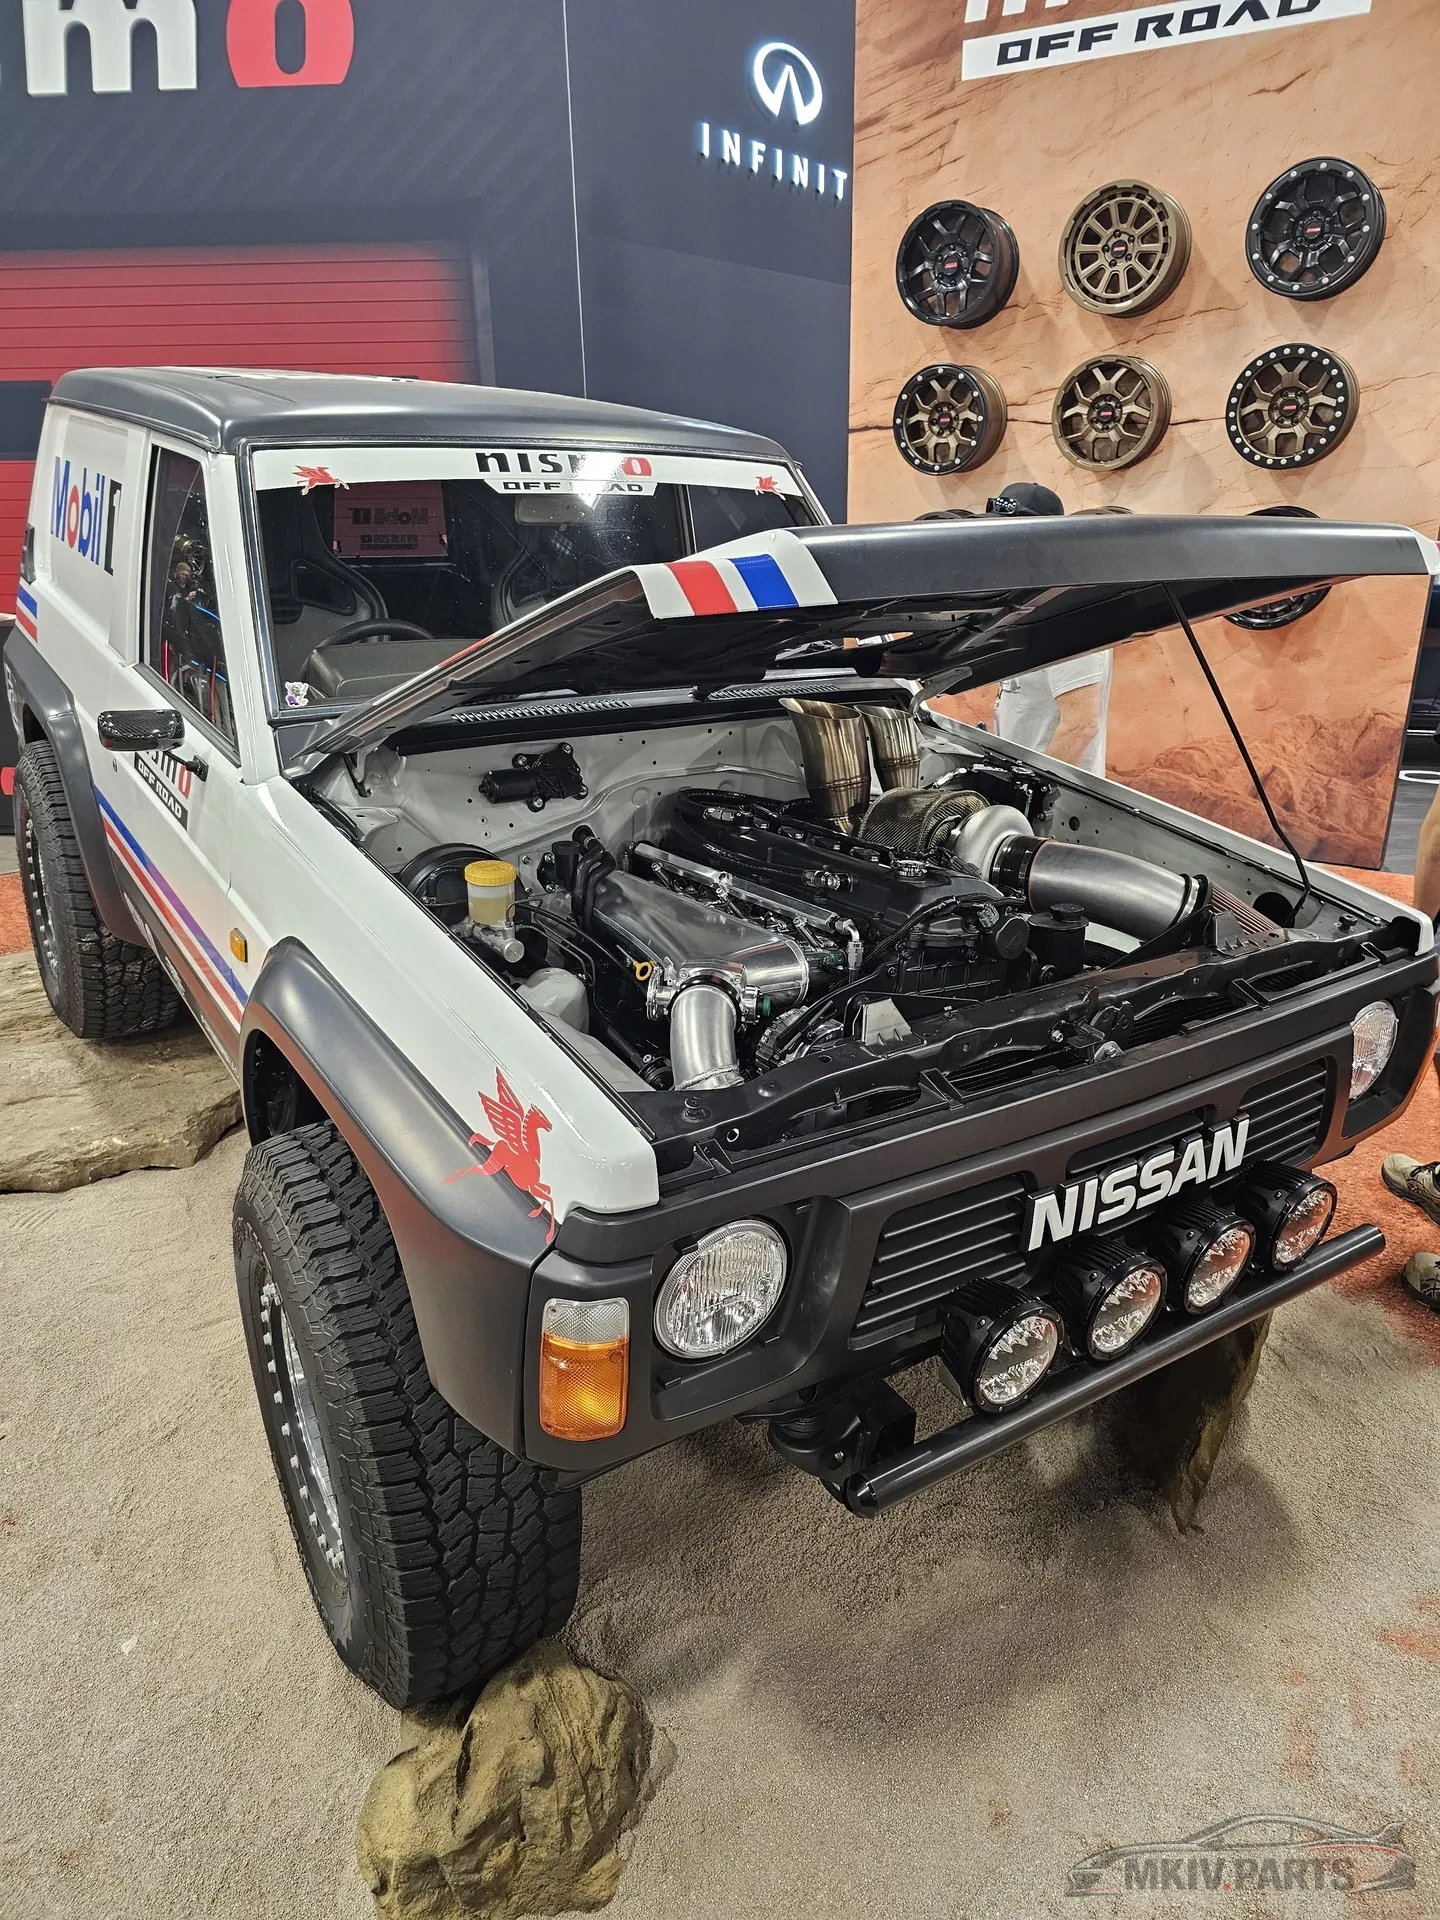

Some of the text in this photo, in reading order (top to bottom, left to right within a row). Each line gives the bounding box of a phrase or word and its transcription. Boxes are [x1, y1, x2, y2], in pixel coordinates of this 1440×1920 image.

[996, 23, 1118, 66] OFF
[475, 452, 653, 477] niso
[503, 481, 561, 492] OFF
[51, 455, 106, 566] Mobil
[138, 758, 182, 819] OFF ROAD
[1027, 1113, 1250, 1251] NISSAN
